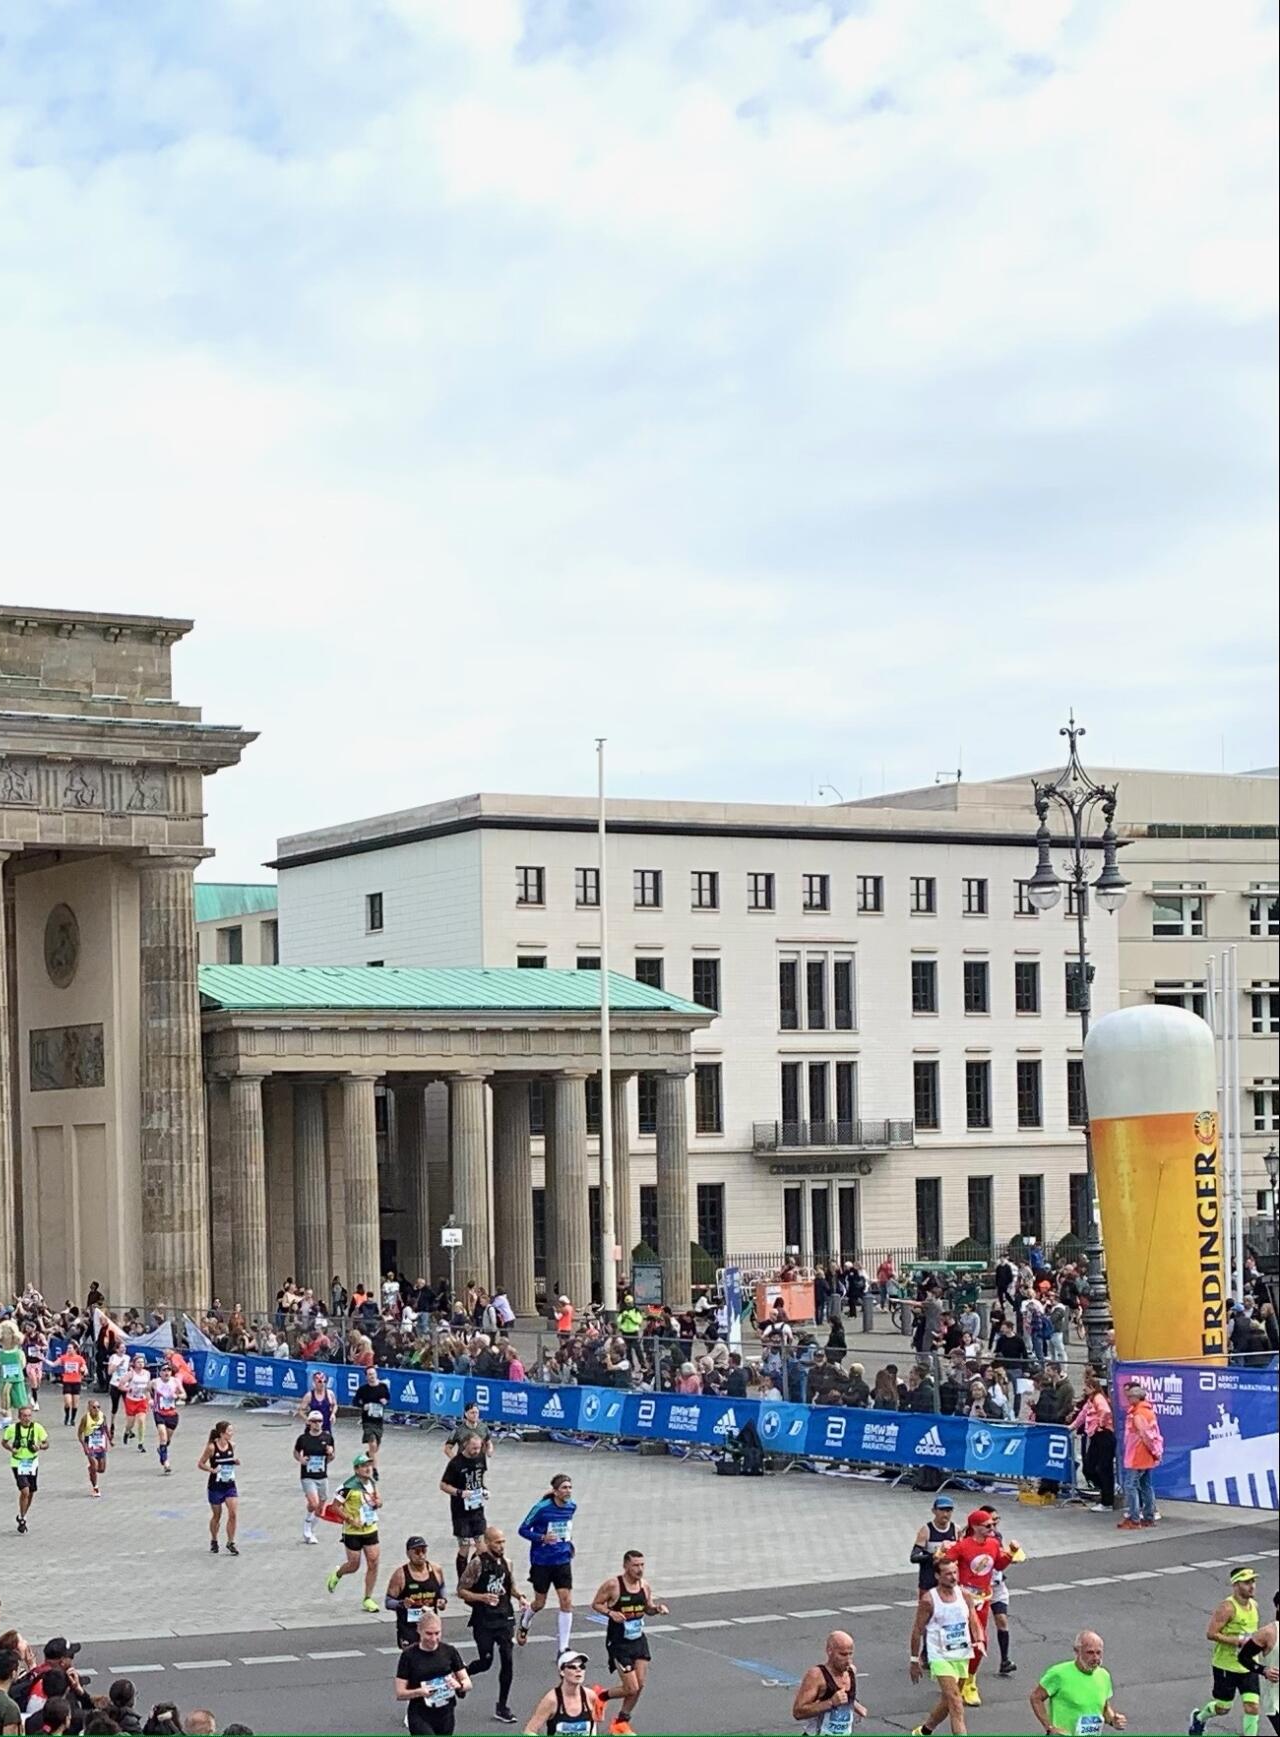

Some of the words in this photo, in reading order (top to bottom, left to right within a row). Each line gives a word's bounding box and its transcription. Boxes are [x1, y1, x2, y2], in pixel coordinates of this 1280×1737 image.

[1194, 1147, 1224, 1357] ERDINGER
[1217, 1375, 1240, 1383] ABBOTT
[1239, 1384, 1271, 1392] MARATHON
[541, 1407, 565, 1419] adidas
[670, 1405, 690, 1416] BMW
[864, 1423, 886, 1434] BMW
[862, 1434, 885, 1443] BERLIN
[861, 1442, 897, 1451] MARATHON
[915, 1444, 946, 1457] adidas
